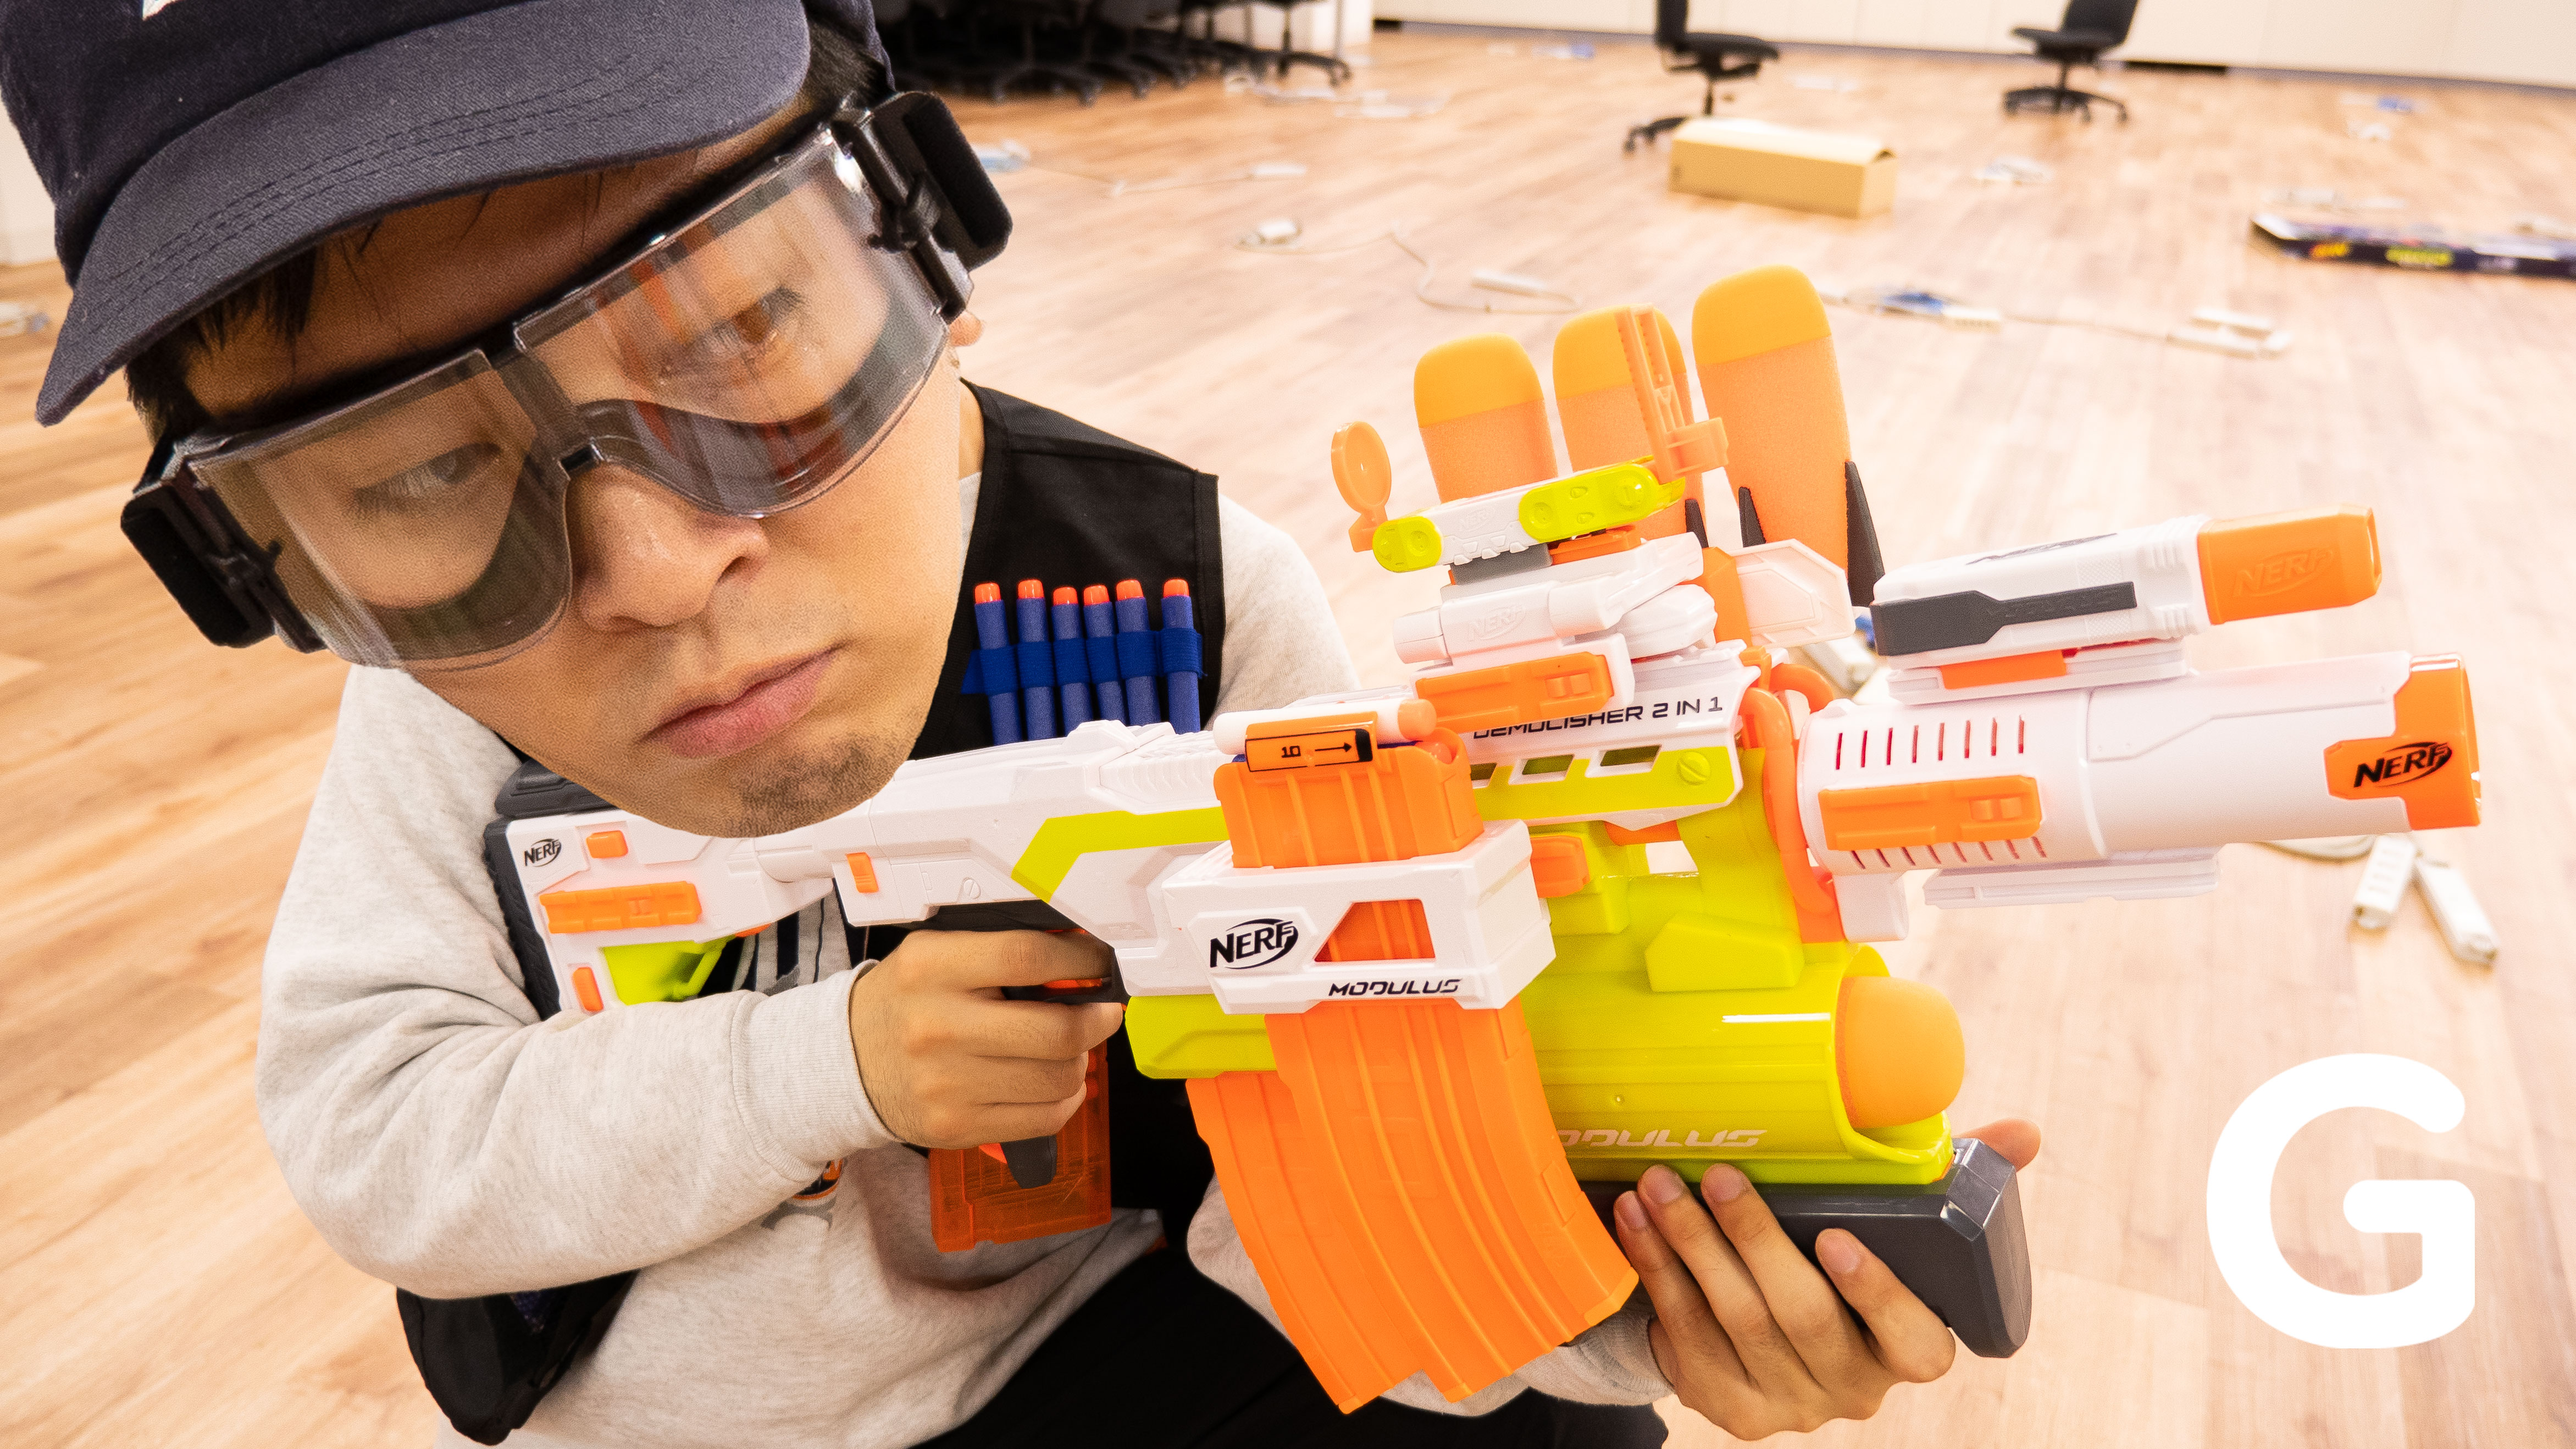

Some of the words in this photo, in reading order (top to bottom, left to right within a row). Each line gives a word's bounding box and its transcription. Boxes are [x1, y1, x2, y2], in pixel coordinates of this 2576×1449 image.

[2231, 549, 2335, 598] NERF
[1467, 605, 1527, 641] NERF
[1652, 703, 1668, 718] 2
[1676, 698, 1700, 715] IN
[1708, 696, 1722, 712] 1
[1281, 745, 1301, 758] 10
[2353, 742, 2452, 788] NERF
[523, 839, 562, 867] NERF
[1210, 919, 1299, 969] NERF
[1328, 978, 1462, 996] MODULUS
[1558, 1129, 1768, 1148] ODULUS
